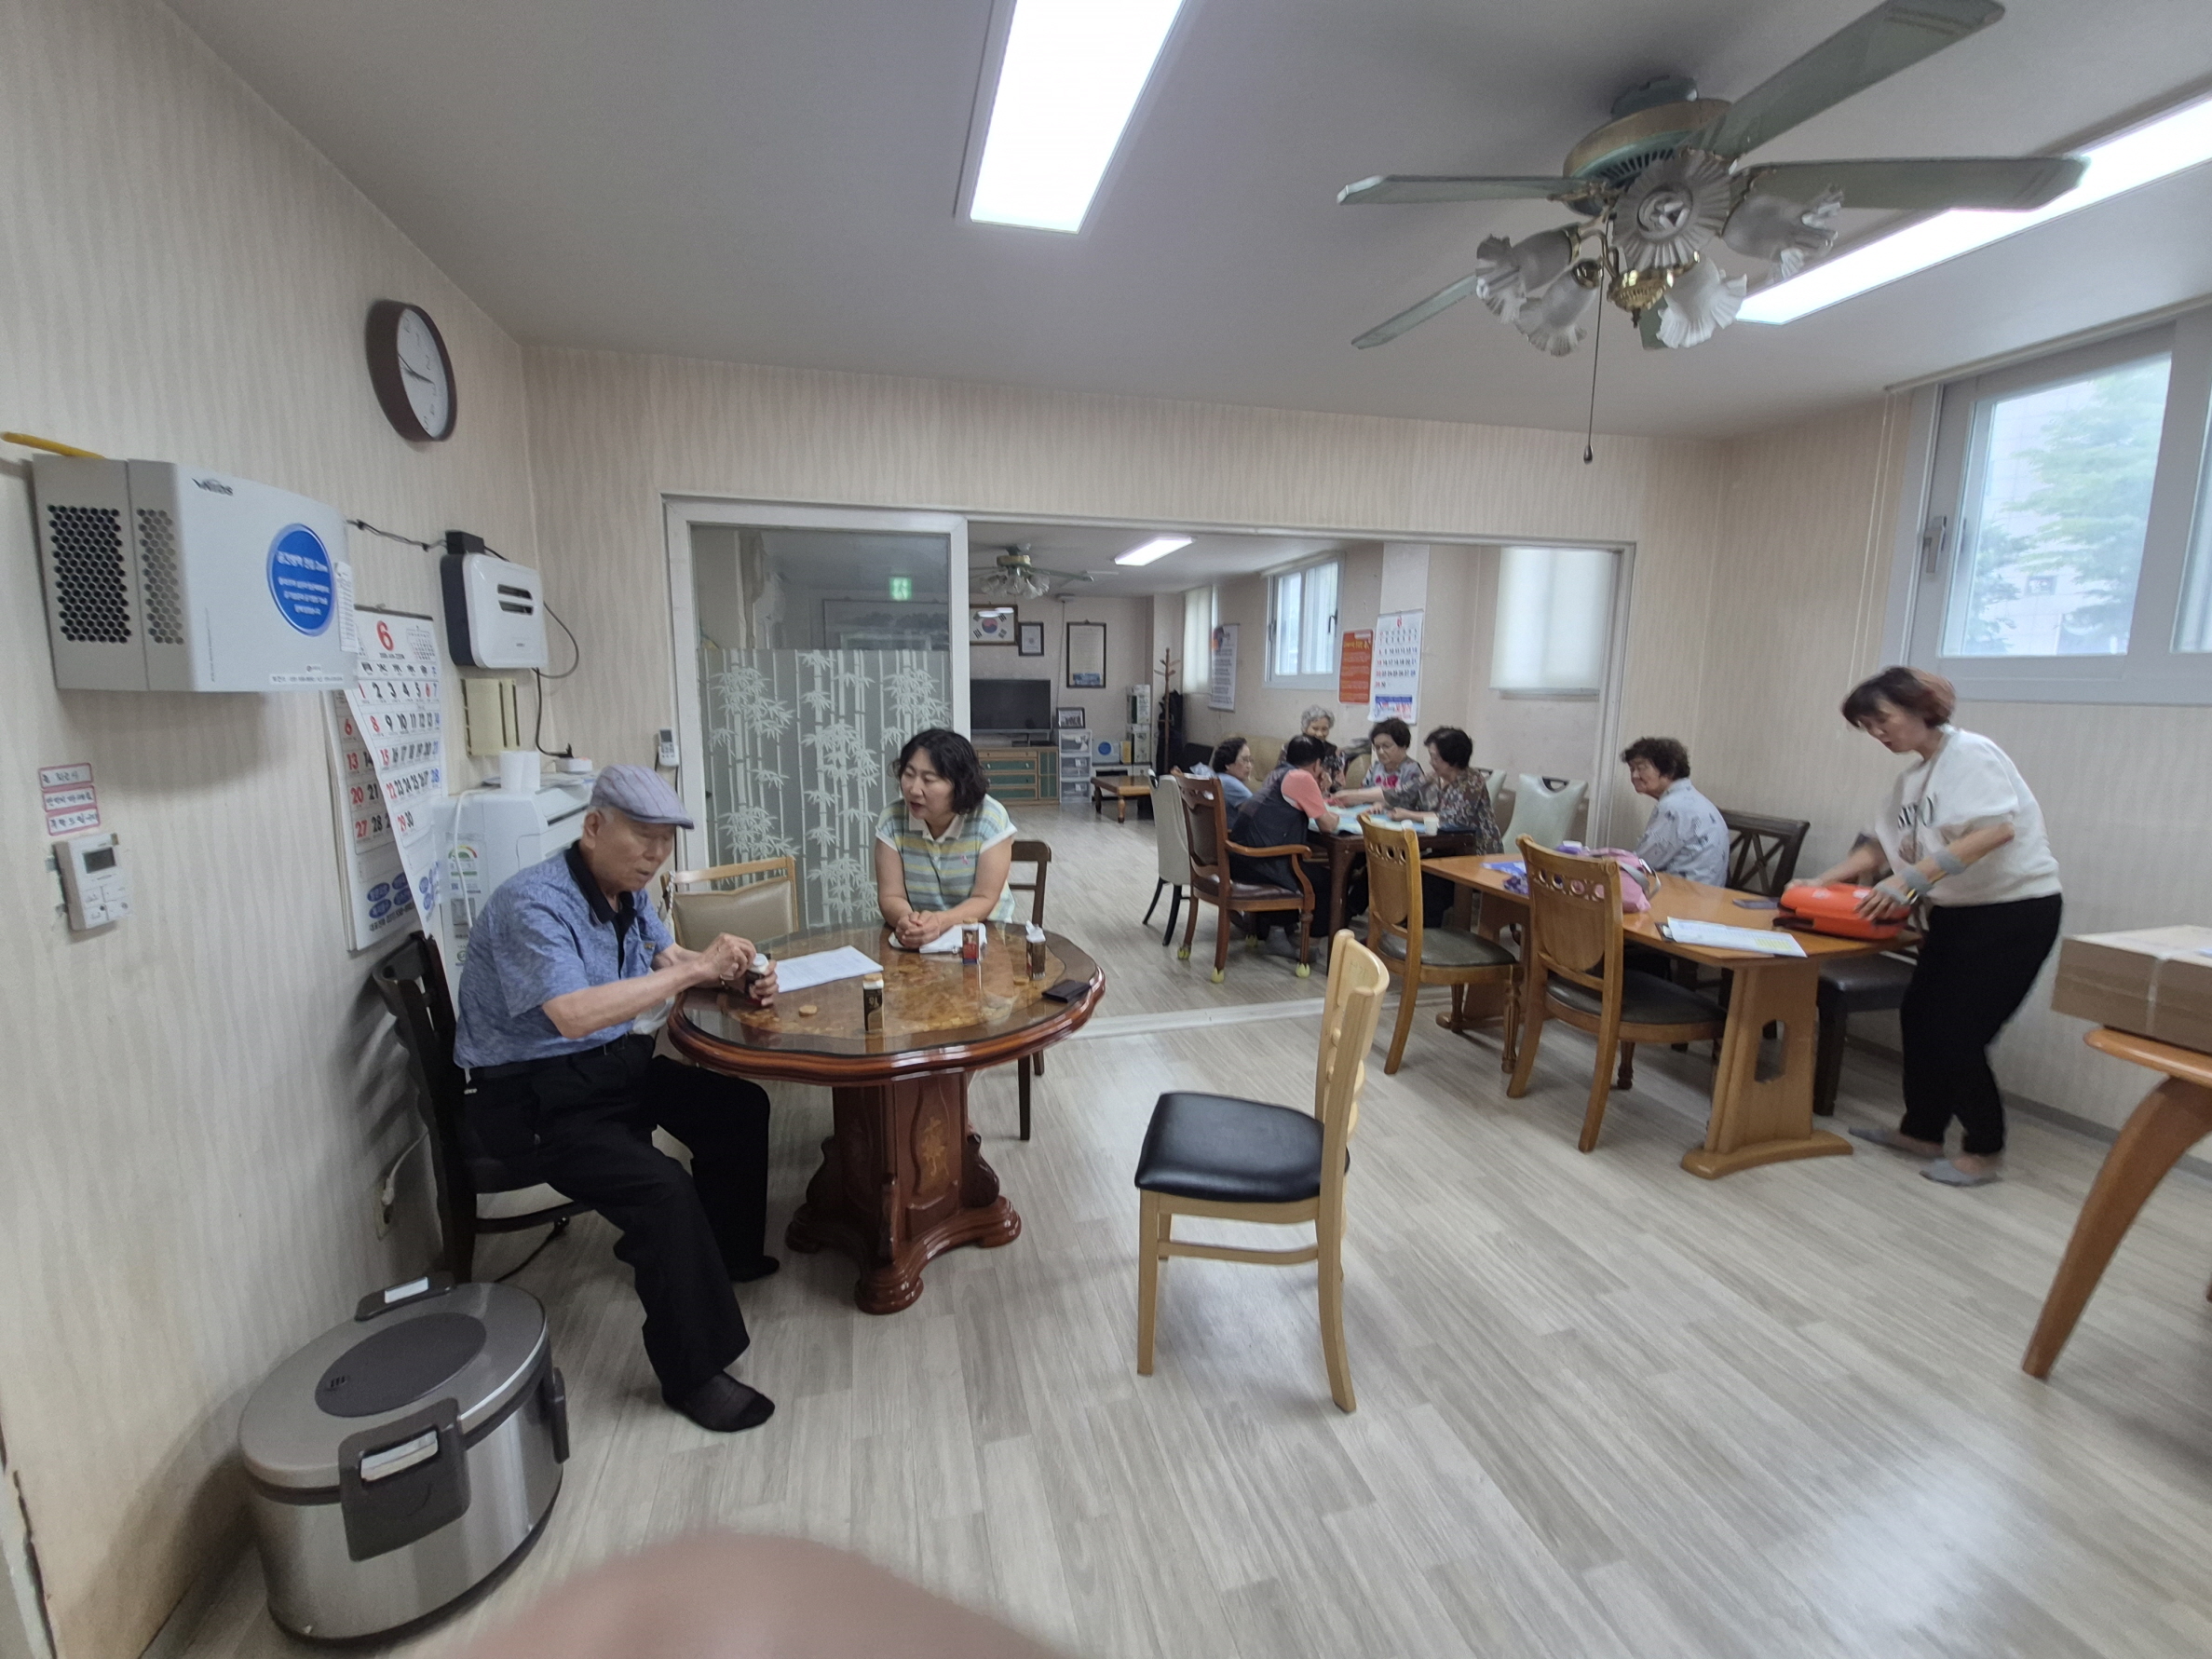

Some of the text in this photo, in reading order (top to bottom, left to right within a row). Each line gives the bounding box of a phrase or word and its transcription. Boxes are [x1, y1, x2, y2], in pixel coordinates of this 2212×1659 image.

[376, 619, 394, 652] 6
[359, 683, 365, 699] 1
[373, 682, 383, 699] 2
[387, 682, 397, 699] 3
[402, 682, 410, 697] 4
[414, 682, 421, 698] 5
[345, 718, 352, 735] 6
[370, 715, 380, 732] 8
[386, 714, 393, 730] 9
[398, 714, 407, 730] 10
[410, 712, 416, 728] 11
[419, 712, 425, 728] 12
[427, 712, 433, 728] 13
[346, 753, 359, 769] 13
[380, 748, 389, 767] 15
[392, 747, 399, 763] 16
[401, 746, 406, 761] 17
[409, 744, 414, 760] 18
[417, 743, 423, 759] 19
[425, 741, 431, 756] 20
[350, 784, 378, 805] 20 21
[387, 783, 397, 800] 22
[395, 780, 404, 796] 23
[402, 778, 411, 794] 24
[411, 774, 418, 790] 25
[431, 768, 440, 783] 28
[356, 820, 367, 838] 27
[372, 815, 383, 833] 28
[398, 810, 414, 832] 29 30
